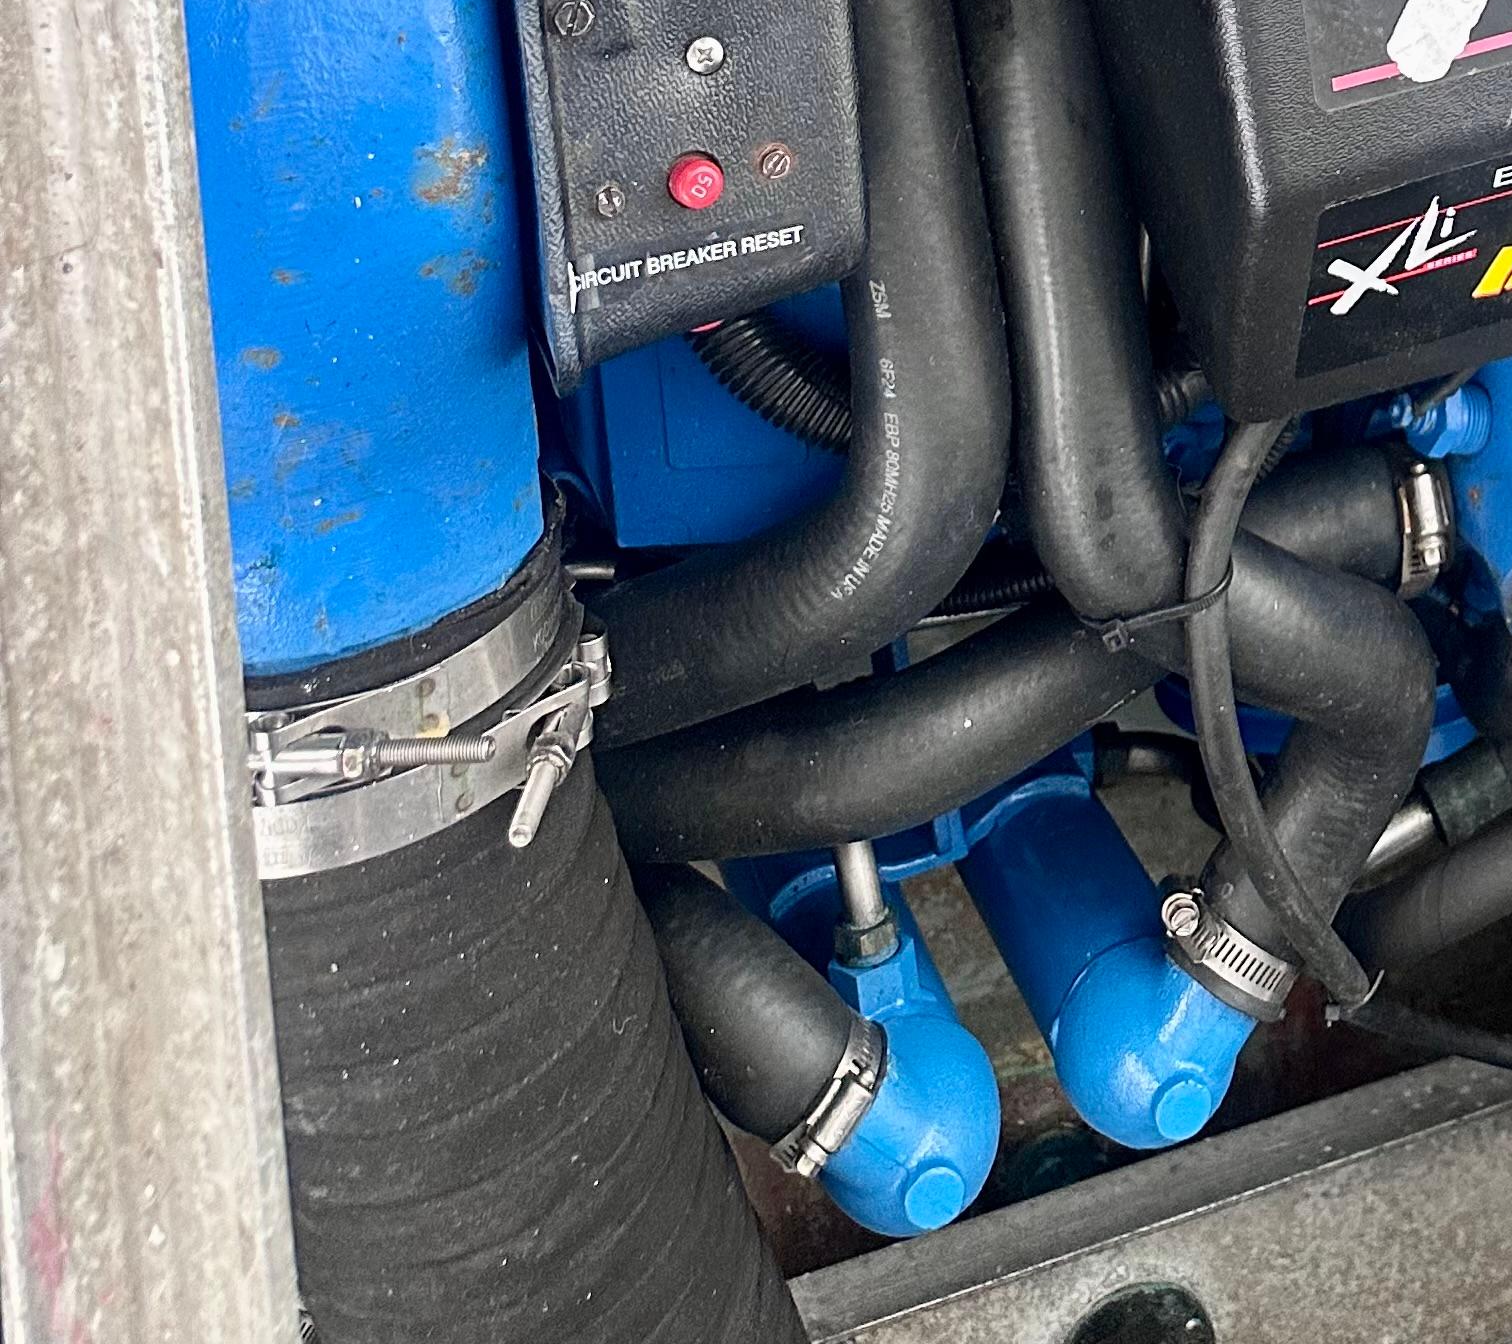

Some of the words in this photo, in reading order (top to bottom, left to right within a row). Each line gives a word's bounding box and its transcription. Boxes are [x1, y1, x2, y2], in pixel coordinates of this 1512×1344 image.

[690, 171, 713, 199] 50
[646, 239, 739, 277] BREAKER
[740, 224, 804, 255] RESET
[869, 279, 891, 320] ZSM
[879, 357, 897, 400] 6F24
[882, 411, 900, 448] EBP
[862, 513, 893, 564] MADE
[851, 561, 871, 582] IN
